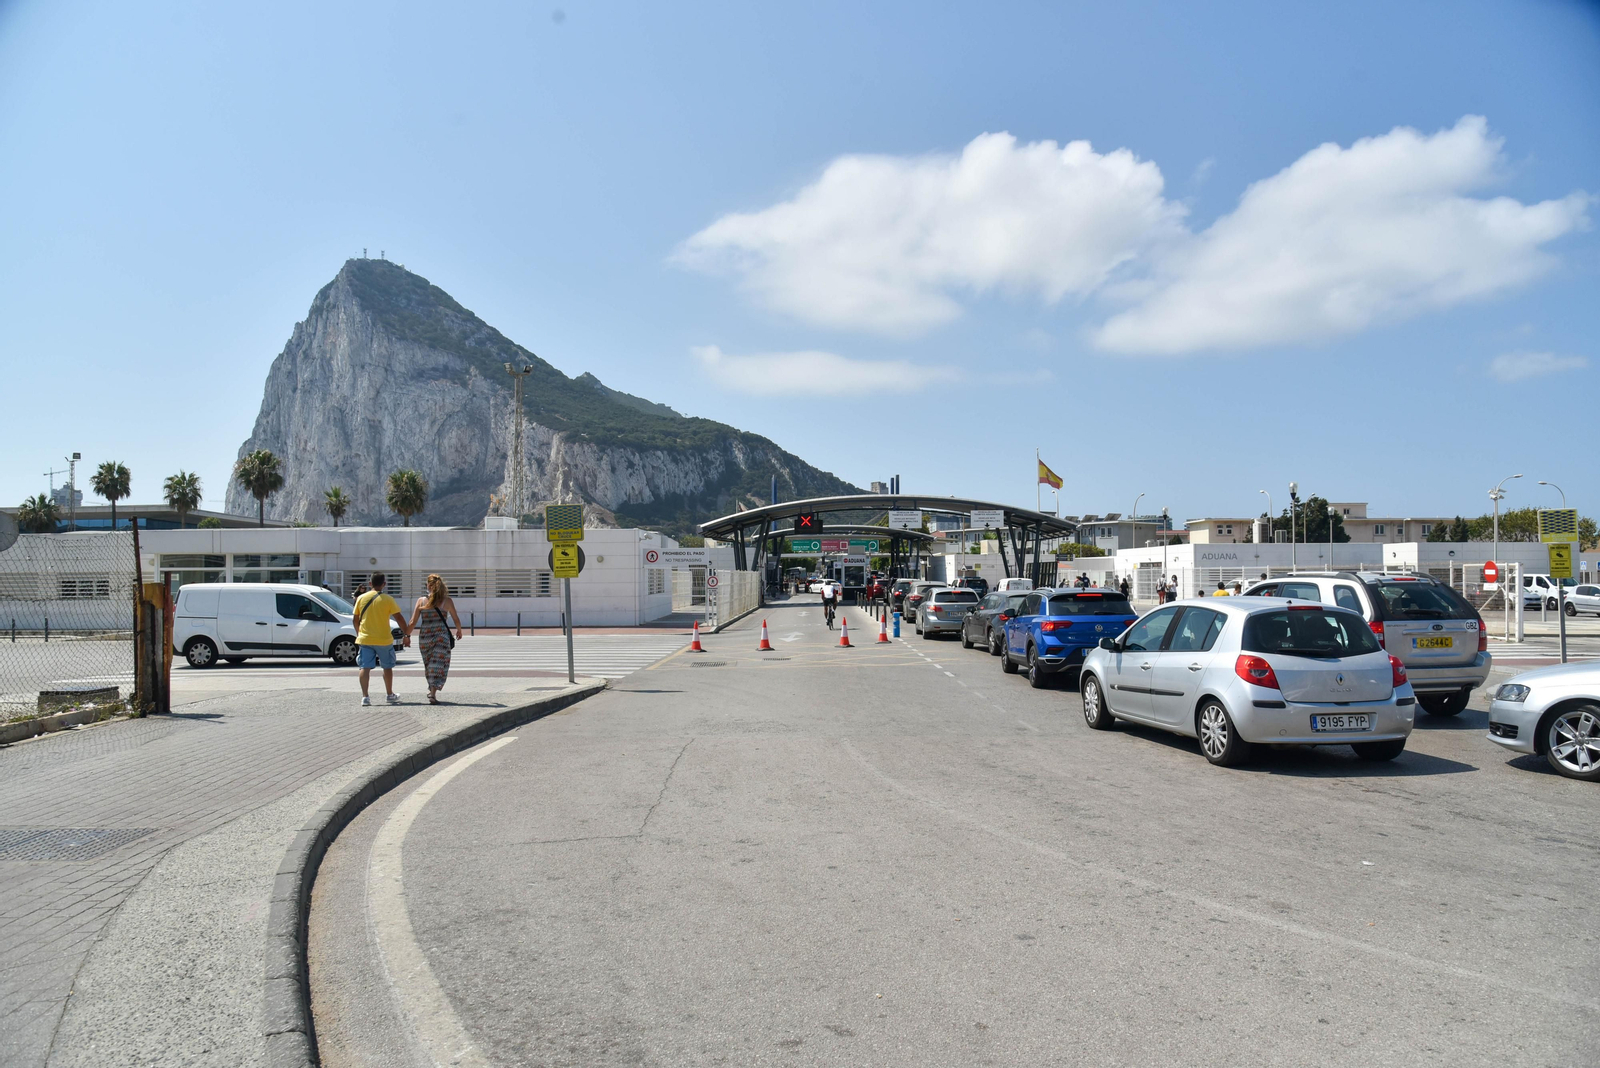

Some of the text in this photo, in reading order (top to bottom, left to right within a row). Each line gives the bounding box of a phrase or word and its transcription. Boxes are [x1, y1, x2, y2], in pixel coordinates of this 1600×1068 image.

[1201, 552, 1238, 560] ADUANA
[1465, 622, 1478, 630] GBZ
[1320, 716, 1366, 728] 9195 FYP
